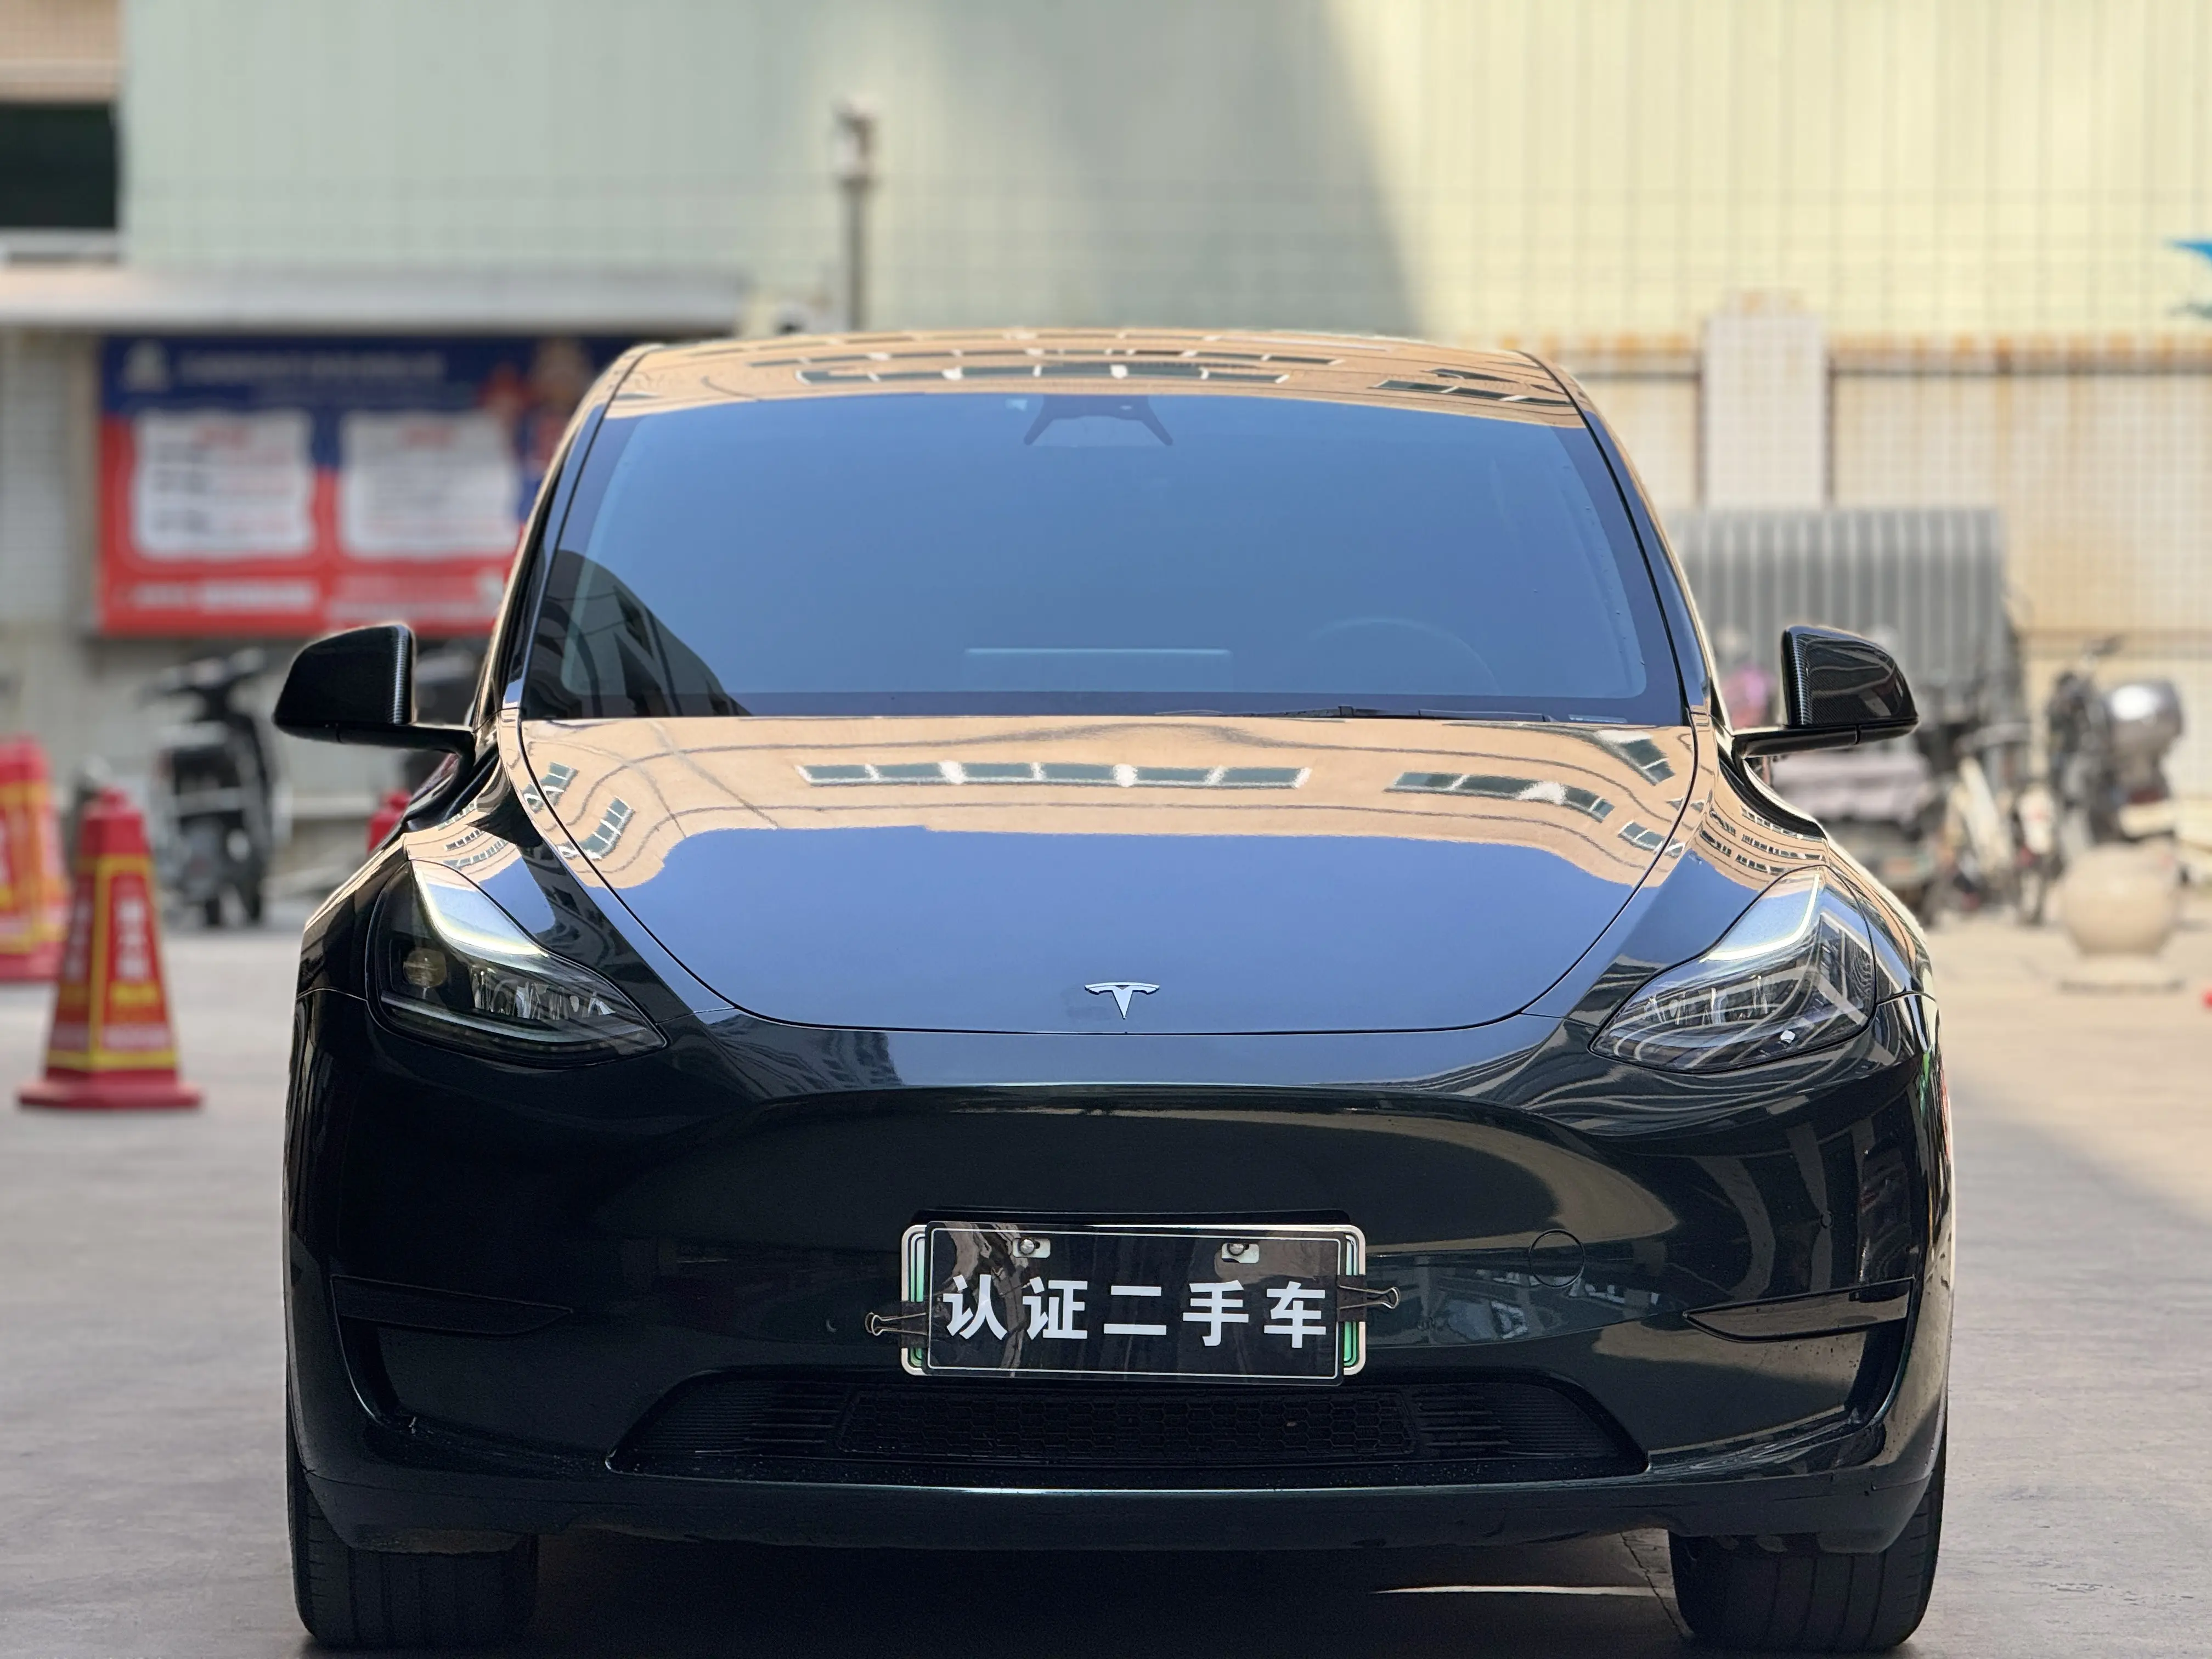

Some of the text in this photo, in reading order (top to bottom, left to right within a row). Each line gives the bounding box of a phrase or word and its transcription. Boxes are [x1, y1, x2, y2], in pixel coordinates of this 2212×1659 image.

[943, 1273, 1327, 1348] 认证二手车
